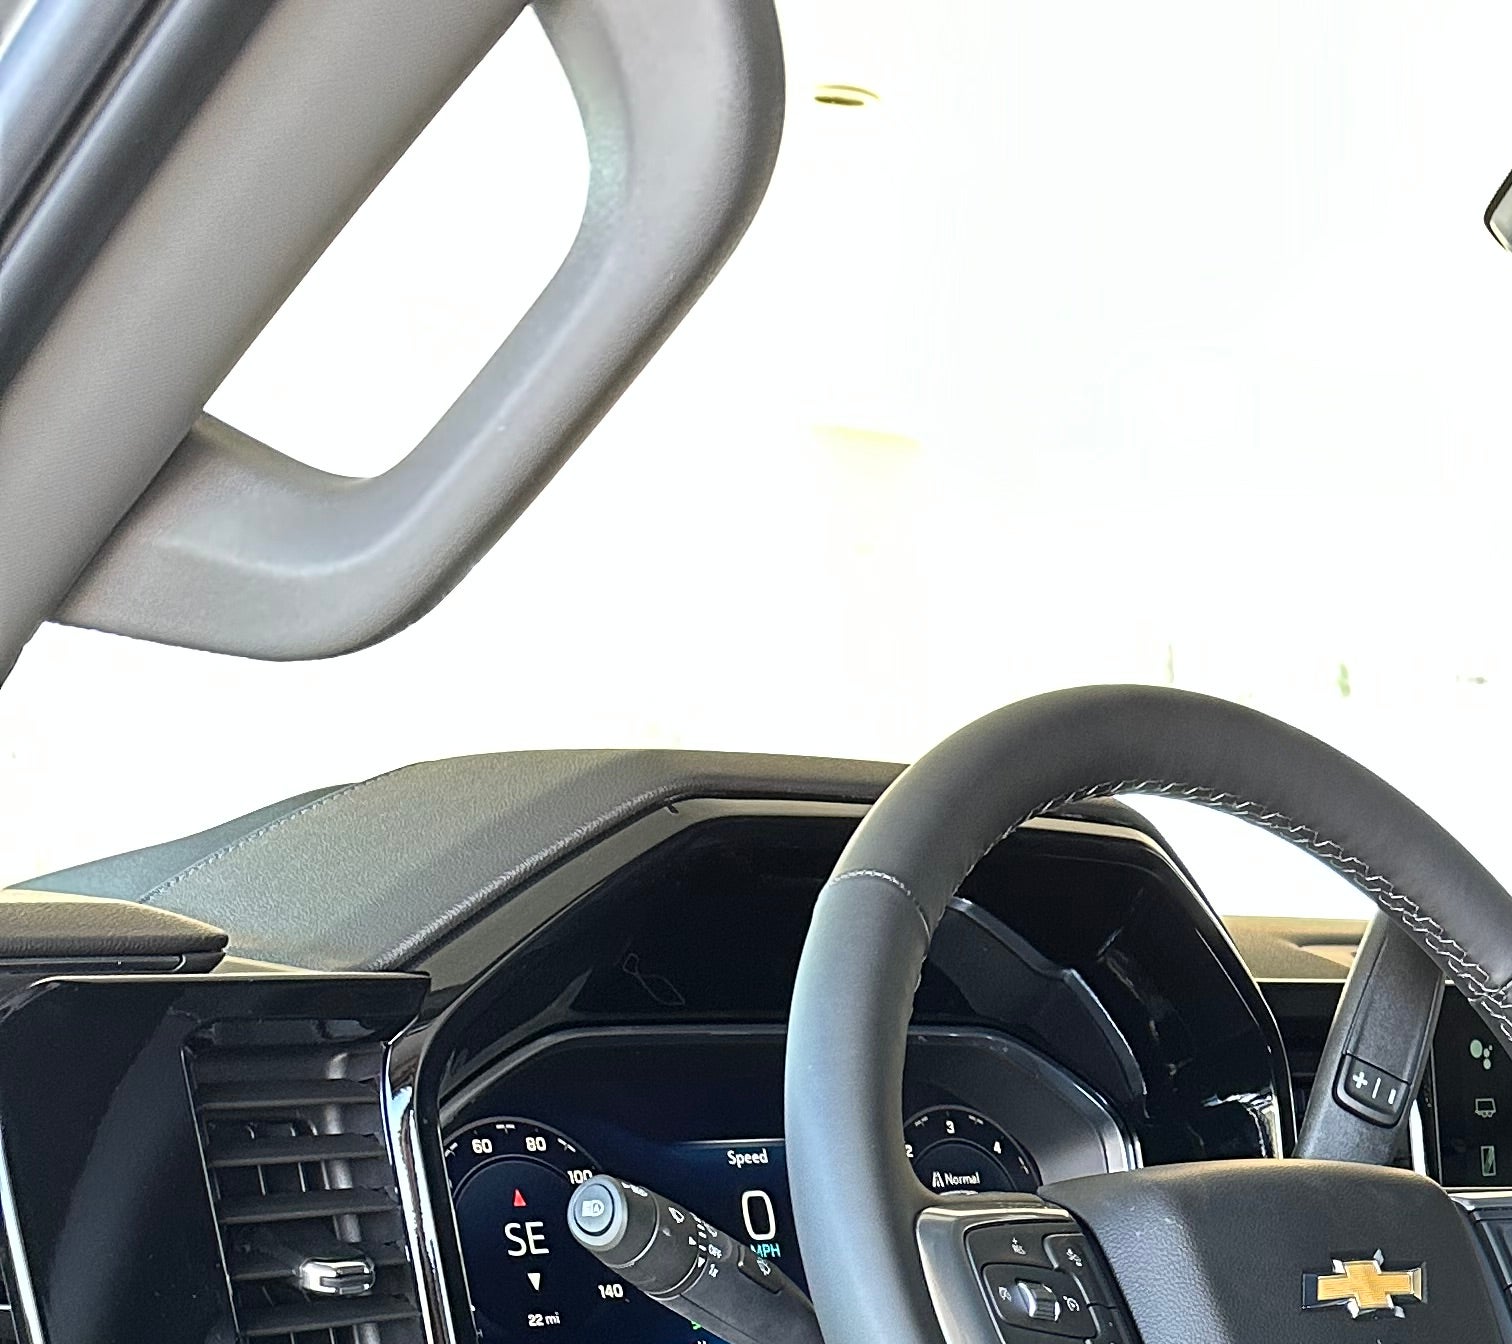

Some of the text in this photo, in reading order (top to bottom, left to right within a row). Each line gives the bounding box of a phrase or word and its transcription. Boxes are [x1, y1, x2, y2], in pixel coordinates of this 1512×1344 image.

[945, 1120, 956, 1135] 3
[471, 1138, 493, 1154] 60
[525, 1136, 547, 1152] 80
[993, 1140, 1003, 1155] 4
[726, 1148, 770, 1168] Speed
[567, 1170, 593, 1185] 100
[944, 1171, 981, 1186] Normal
[741, 1189, 776, 1241] 0
[504, 1221, 550, 1257] SE
[598, 1284, 624, 1298] 140
[528, 1312, 560, 1327] 22 mi
